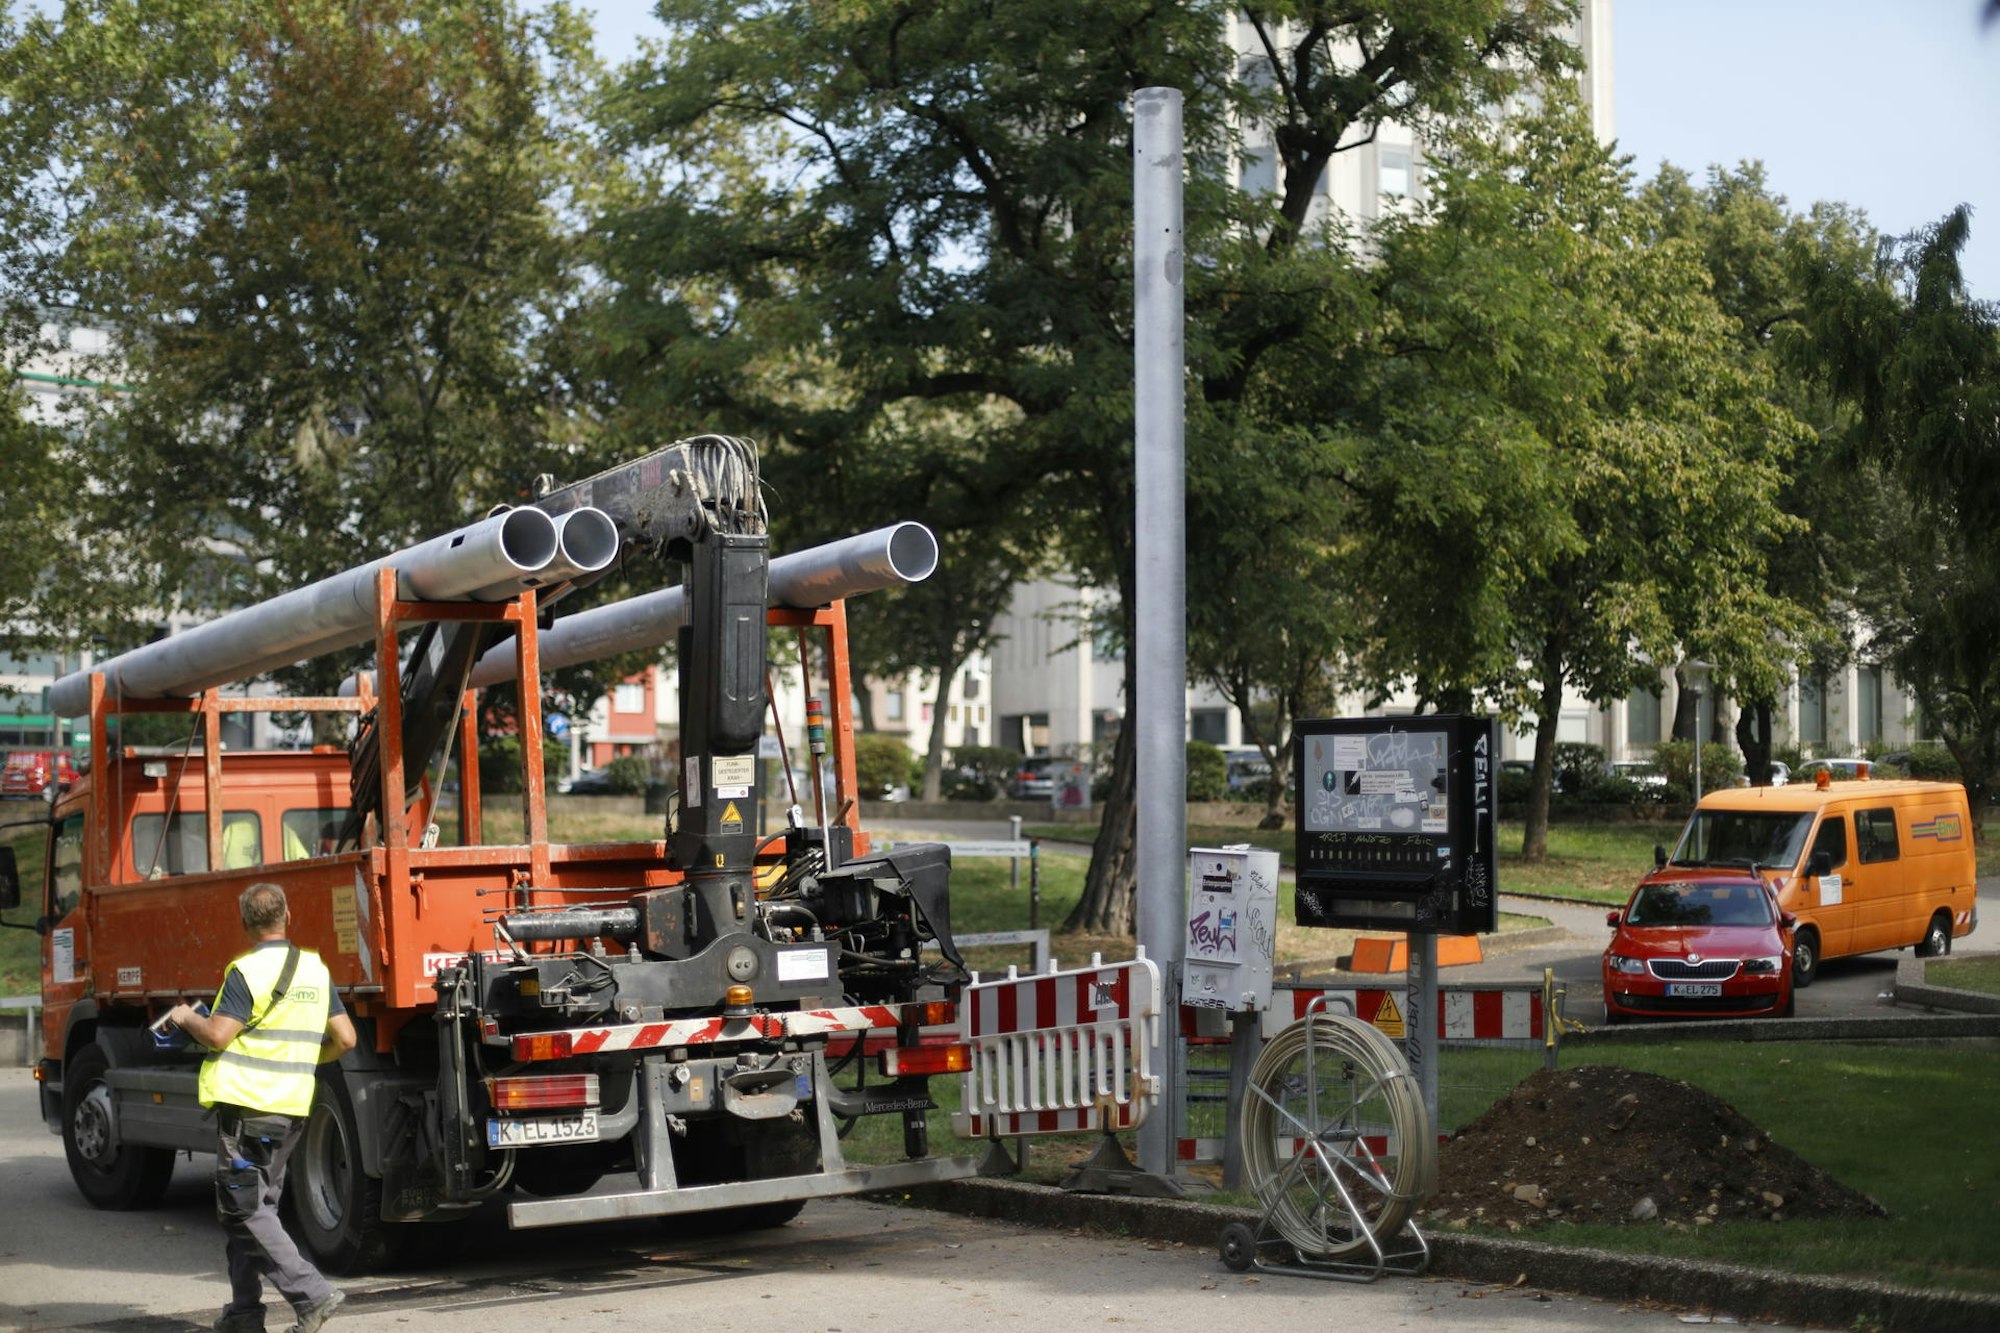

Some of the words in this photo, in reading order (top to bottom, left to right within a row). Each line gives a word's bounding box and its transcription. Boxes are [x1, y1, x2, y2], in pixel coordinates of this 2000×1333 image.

[1701, 985, 1718, 994] 275
[865, 1098, 929, 1113] Mercedes-Benz
[500, 1121, 512, 1142] K
[523, 1118, 547, 1140] EL
[551, 1116, 595, 1138] 1523
